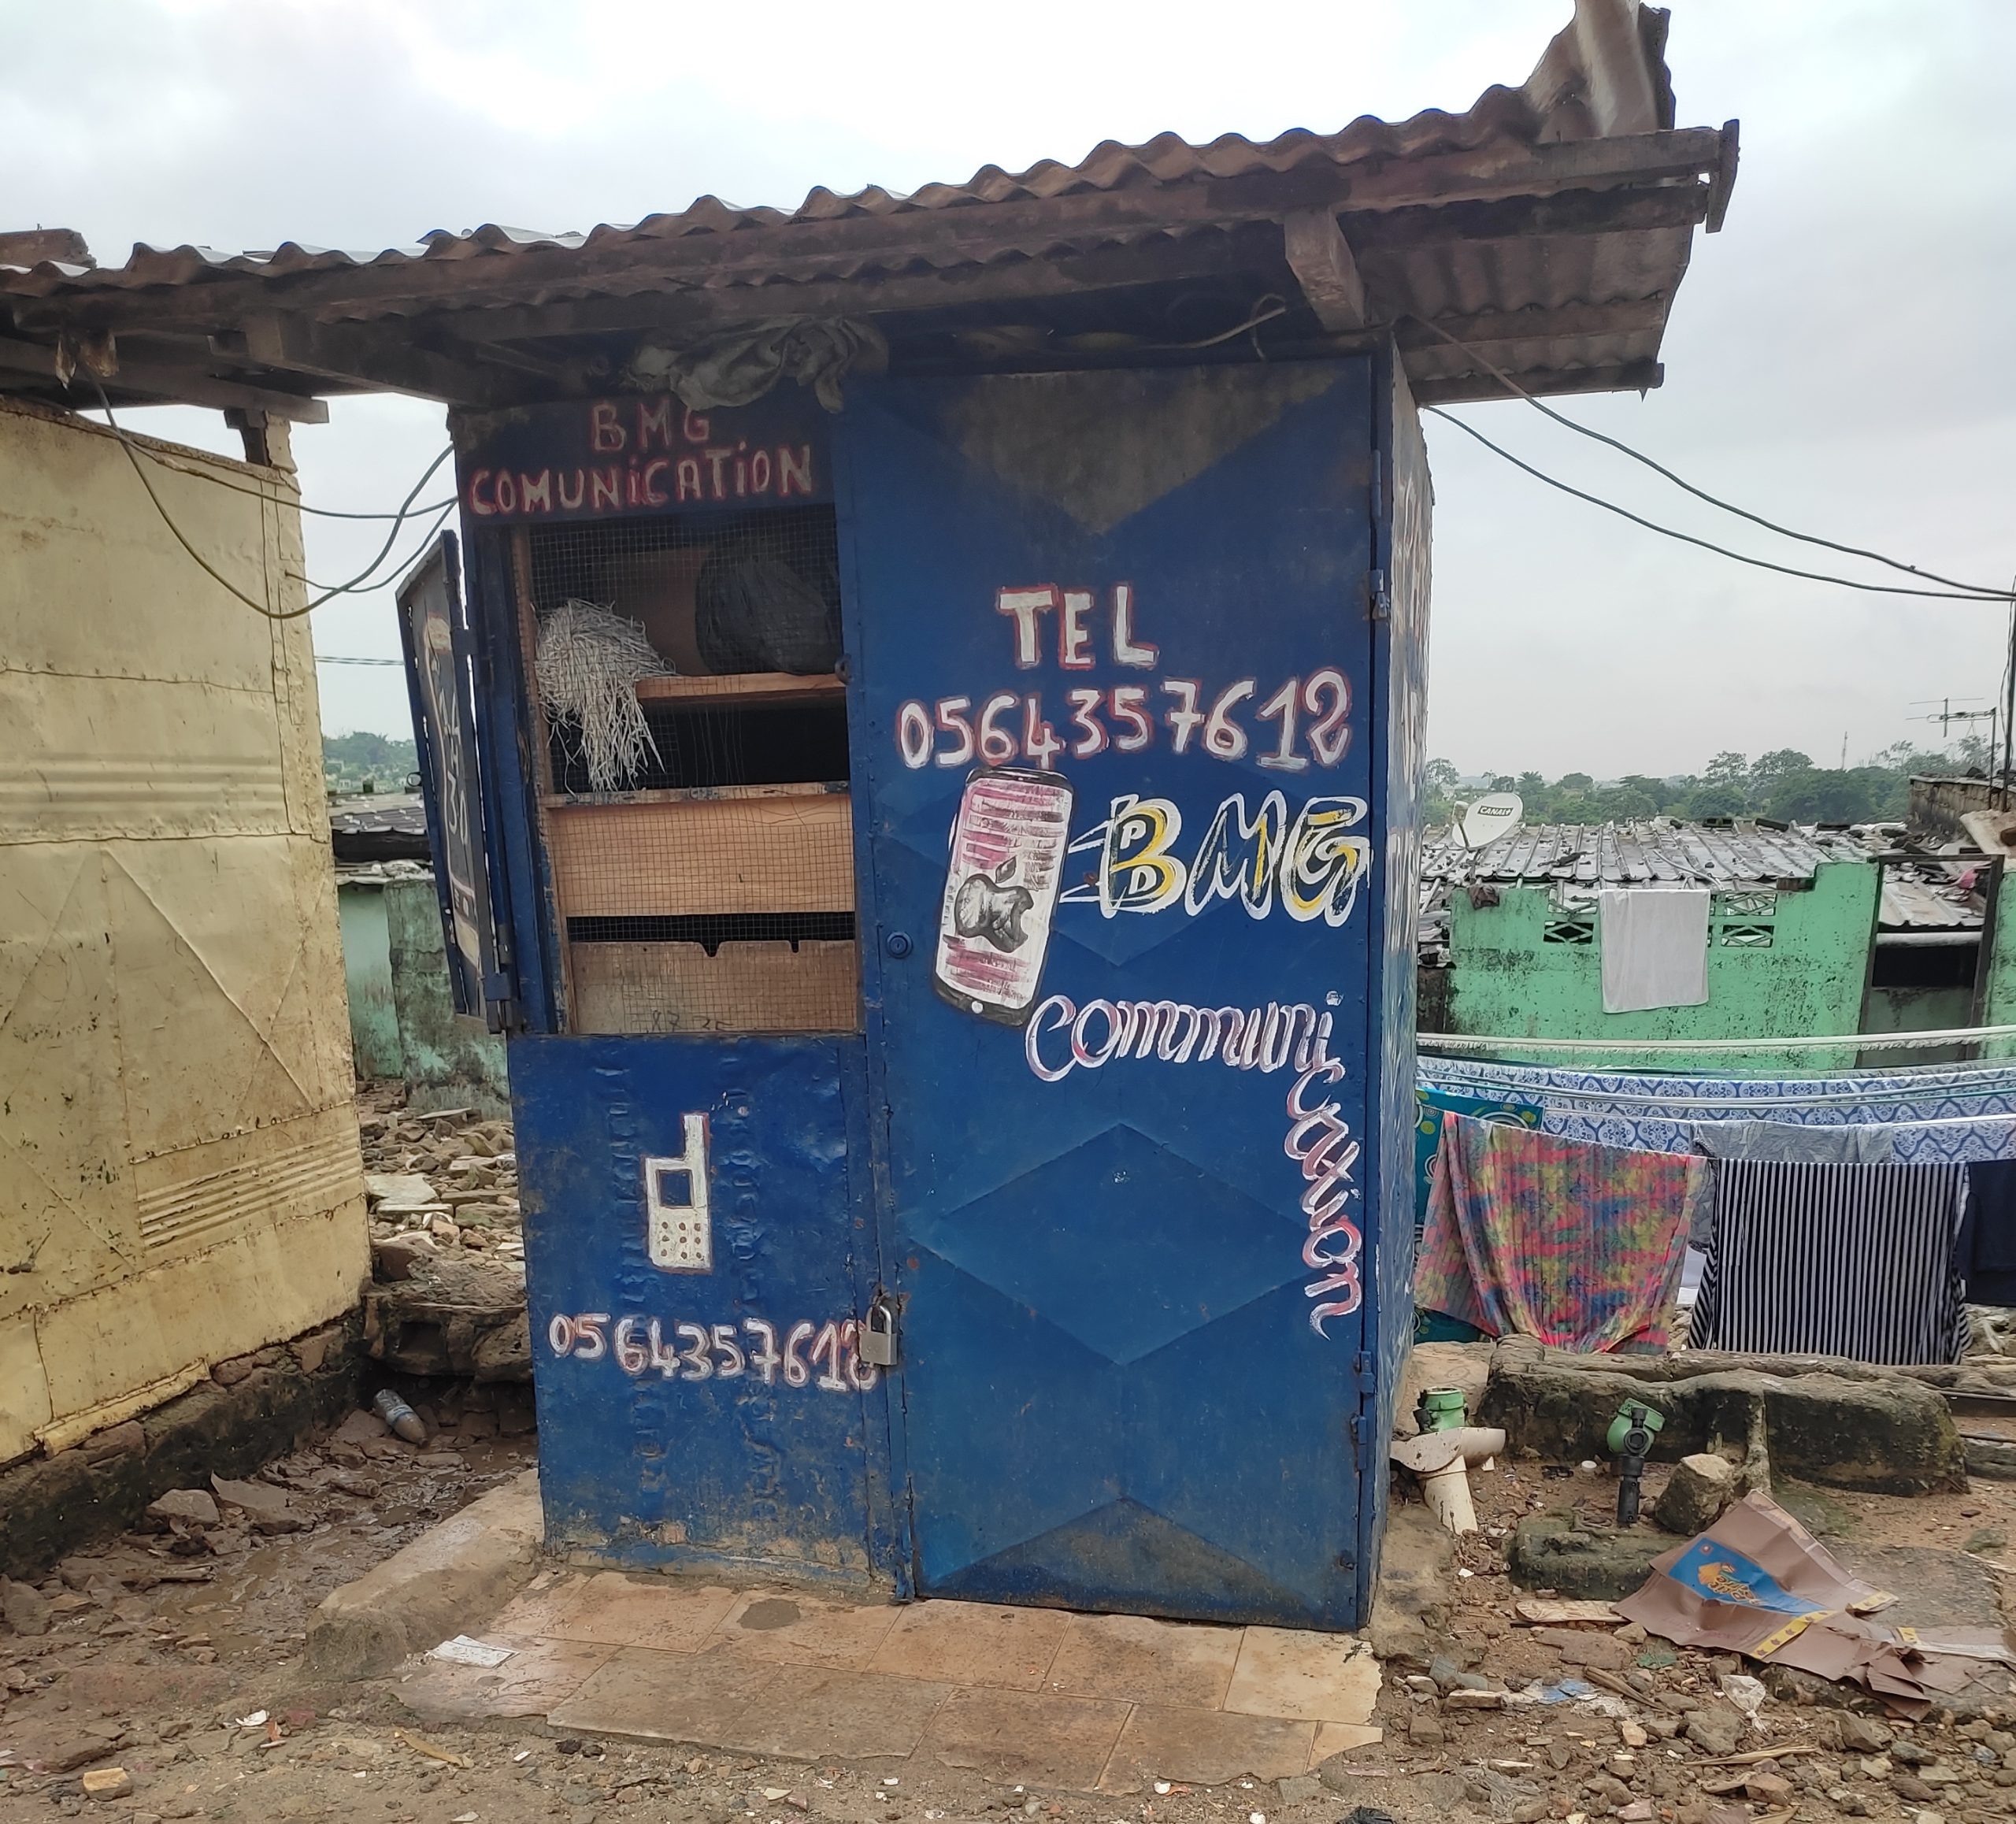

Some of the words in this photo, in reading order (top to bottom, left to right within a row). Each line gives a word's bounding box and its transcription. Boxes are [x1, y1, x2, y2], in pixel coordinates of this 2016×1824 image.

[995, 581, 1160, 670] TEL
[894, 665, 1353, 773] 0564357612
[1099, 789, 1374, 928] BMG
